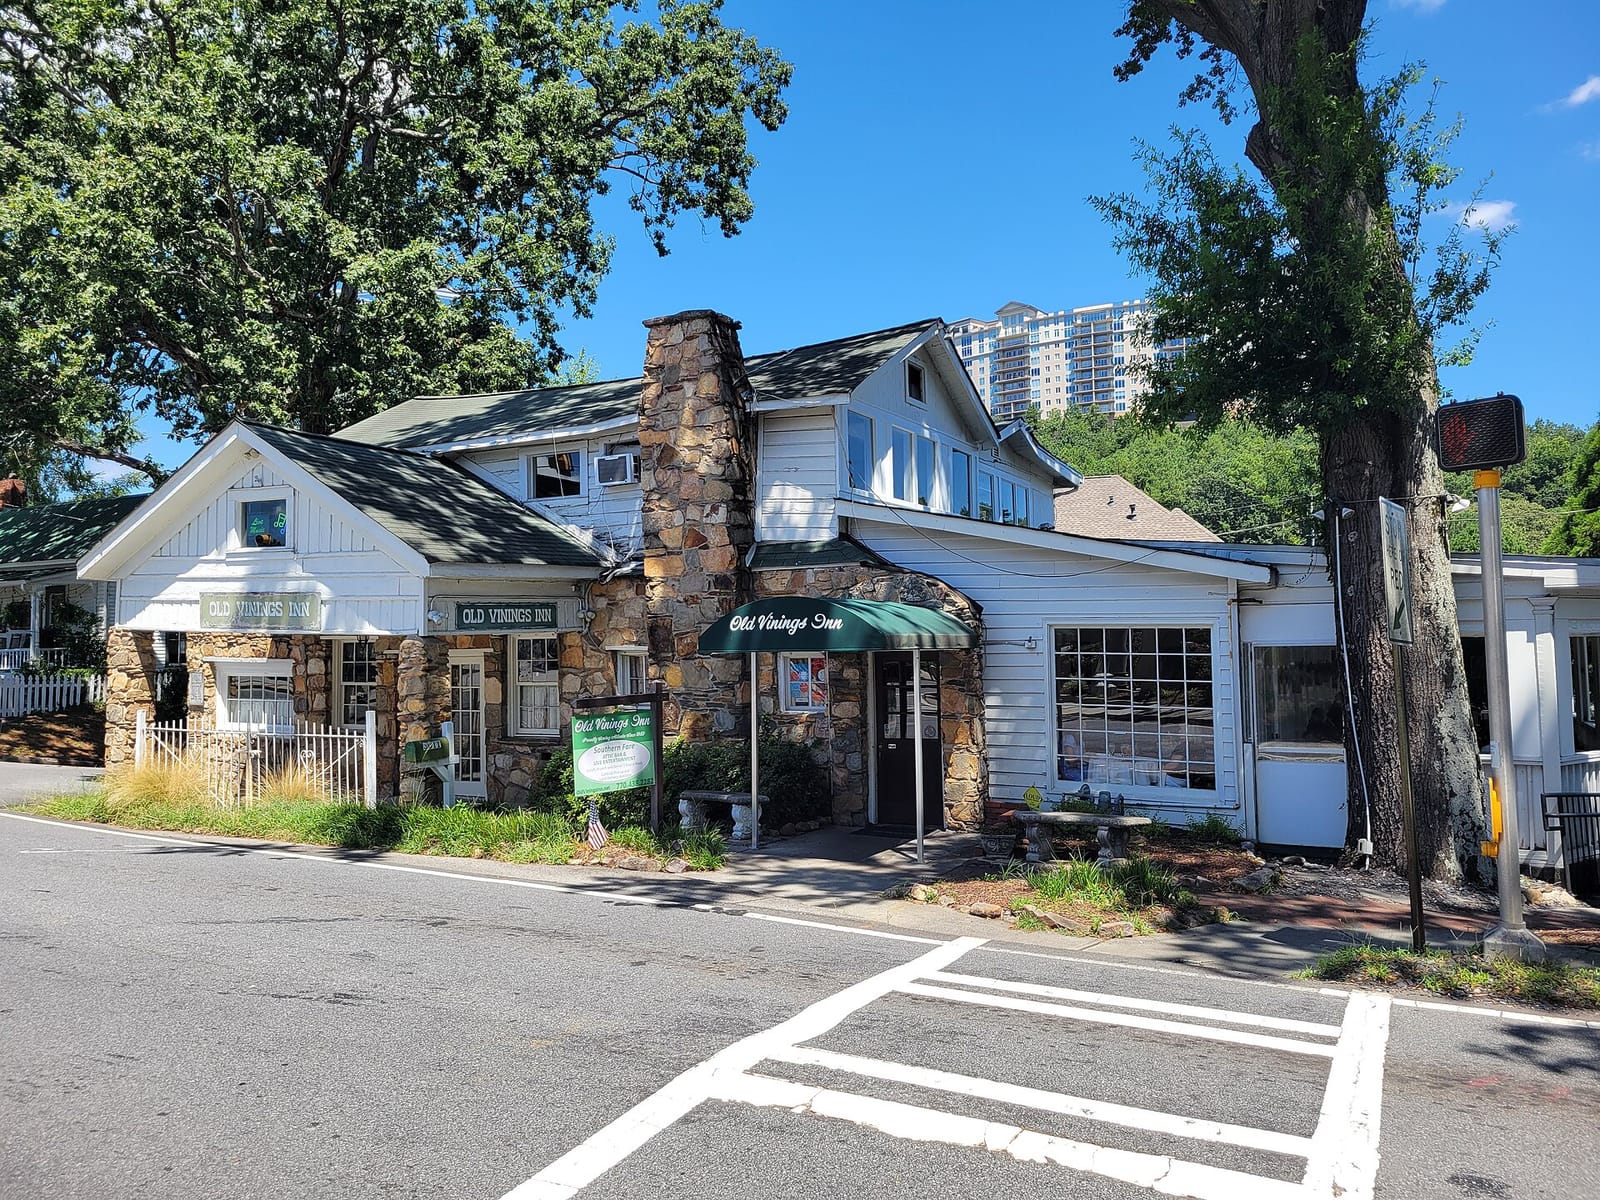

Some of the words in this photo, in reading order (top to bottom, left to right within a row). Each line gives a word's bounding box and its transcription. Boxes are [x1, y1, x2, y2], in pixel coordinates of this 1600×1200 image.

[209, 601, 230, 617] OLD
[236, 601, 284, 617] VININGS
[288, 601, 310, 617] INN
[462, 608, 485, 624] OLD
[488, 608, 532, 623] VININGS
[534, 608, 552, 622] INN
[729, 615, 756, 631] Old
[758, 612, 809, 636] Vinings
[811, 613, 844, 630] Inn
[574, 719, 594, 733] Old
[595, 716, 629, 733] Vinings
[631, 714, 651, 727] Inn
[593, 744, 621, 754] Southern
